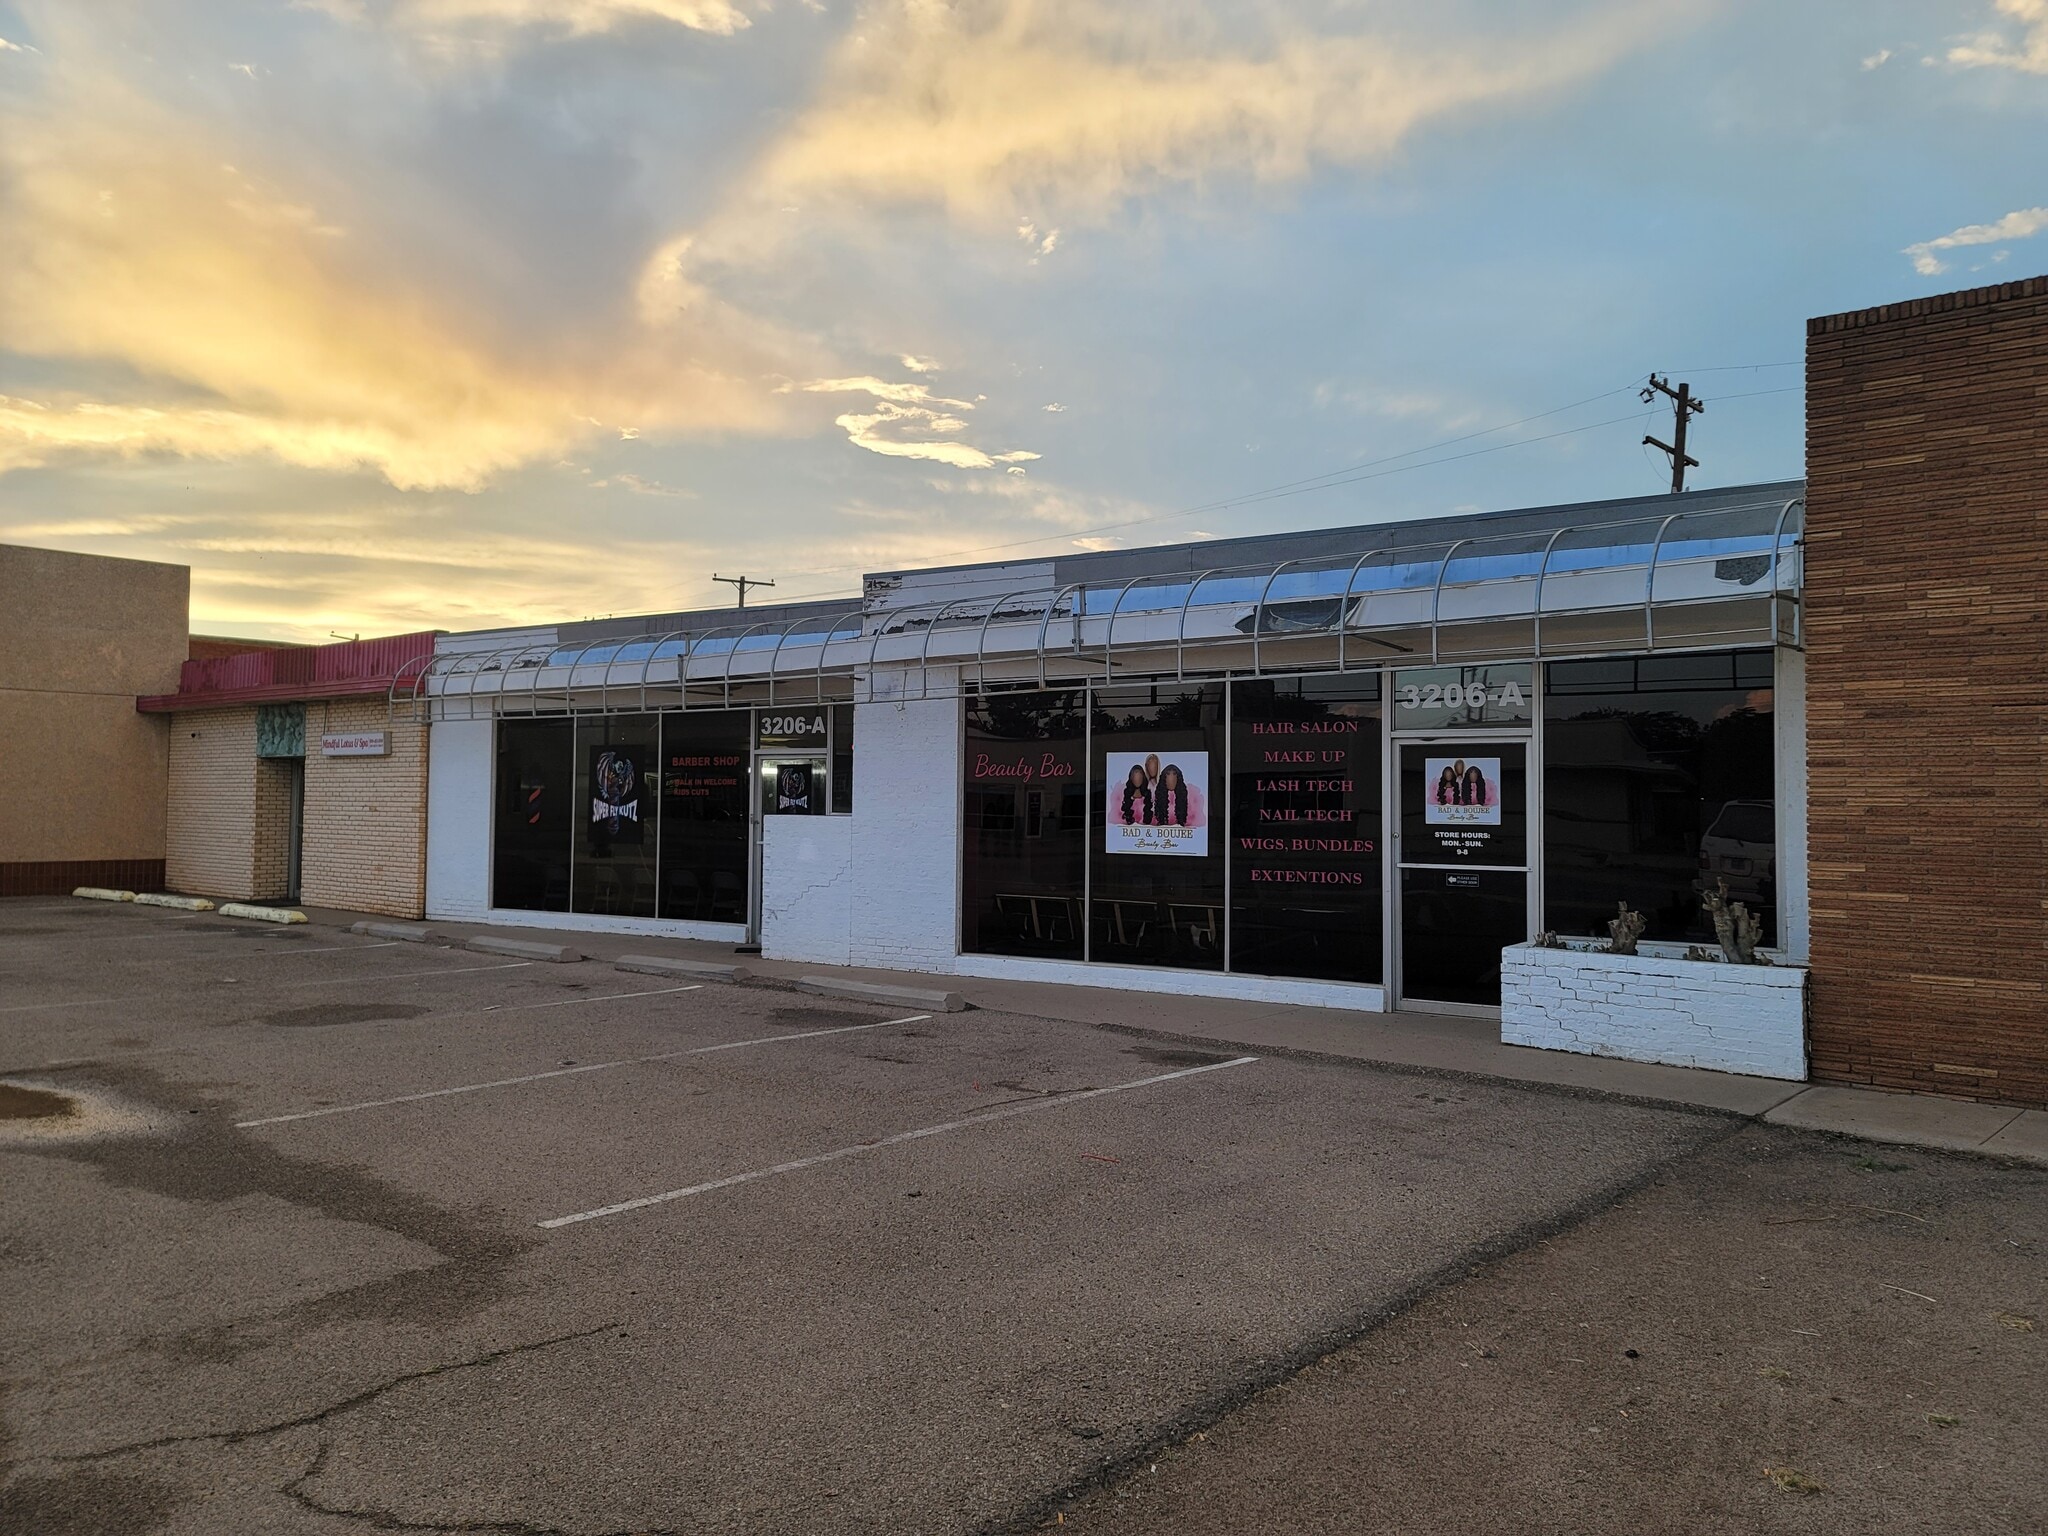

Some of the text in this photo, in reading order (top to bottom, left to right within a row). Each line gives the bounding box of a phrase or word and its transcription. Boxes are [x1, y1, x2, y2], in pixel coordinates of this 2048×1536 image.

[1401, 681, 1526, 709] 3206-A
[761, 716, 826, 735] 3206-A
[1252, 721, 1359, 734] HAIR SALON
[322, 738, 341, 750] Mindful
[341, 738, 353, 748] Lotus
[359, 738, 369, 750] Spa
[672, 756, 740, 767] BARBER SHOP
[1264, 750, 1345, 762] MAKE UP
[975, 752, 1075, 783] Beauty Bar
[704, 778, 737, 786] WELCOME
[1257, 780, 1353, 792] LASH TECH
[673, 788, 709, 796] KIDS CUTS
[593, 797, 609, 823] SUPER
[619, 799, 638, 822] KUTZ
[1260, 809, 1352, 821] NAIL TECH
[1122, 828, 1193, 839] BAD & BOUJEE
[1160, 838, 1179, 849] Bar
[1240, 838, 1374, 852] WIGS, BUNDLES
[1251, 869, 1363, 885] EXTENTIONS
